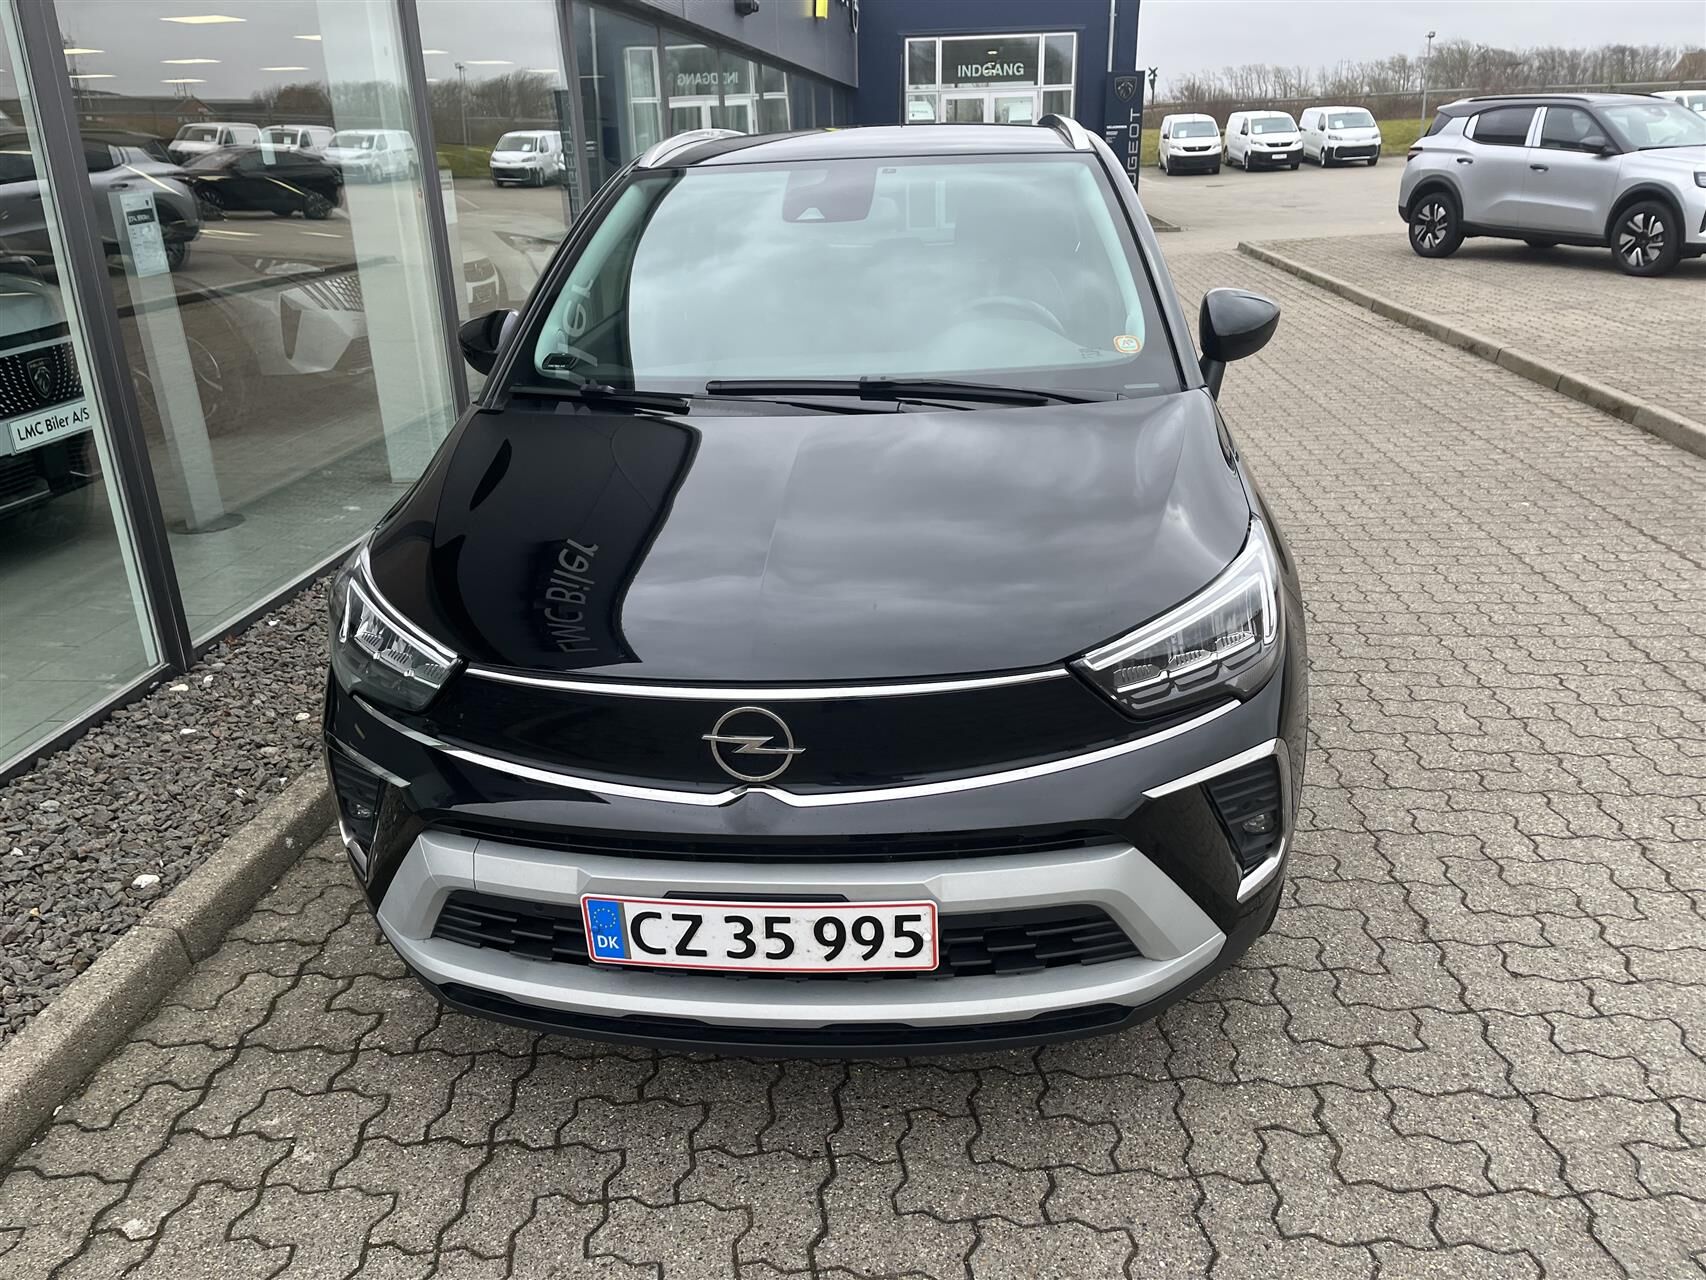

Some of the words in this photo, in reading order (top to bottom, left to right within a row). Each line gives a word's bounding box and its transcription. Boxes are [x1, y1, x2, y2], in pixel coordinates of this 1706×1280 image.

[958, 62, 1024, 77] INDGANG
[17, 422, 44, 441] LMC
[45, 415, 69, 431] Biler
[72, 407, 90, 424] A/S
[597, 935, 620, 949] DK
[630, 911, 707, 957] CZ
[723, 915, 795, 960] 35
[813, 914, 924, 962] 995
